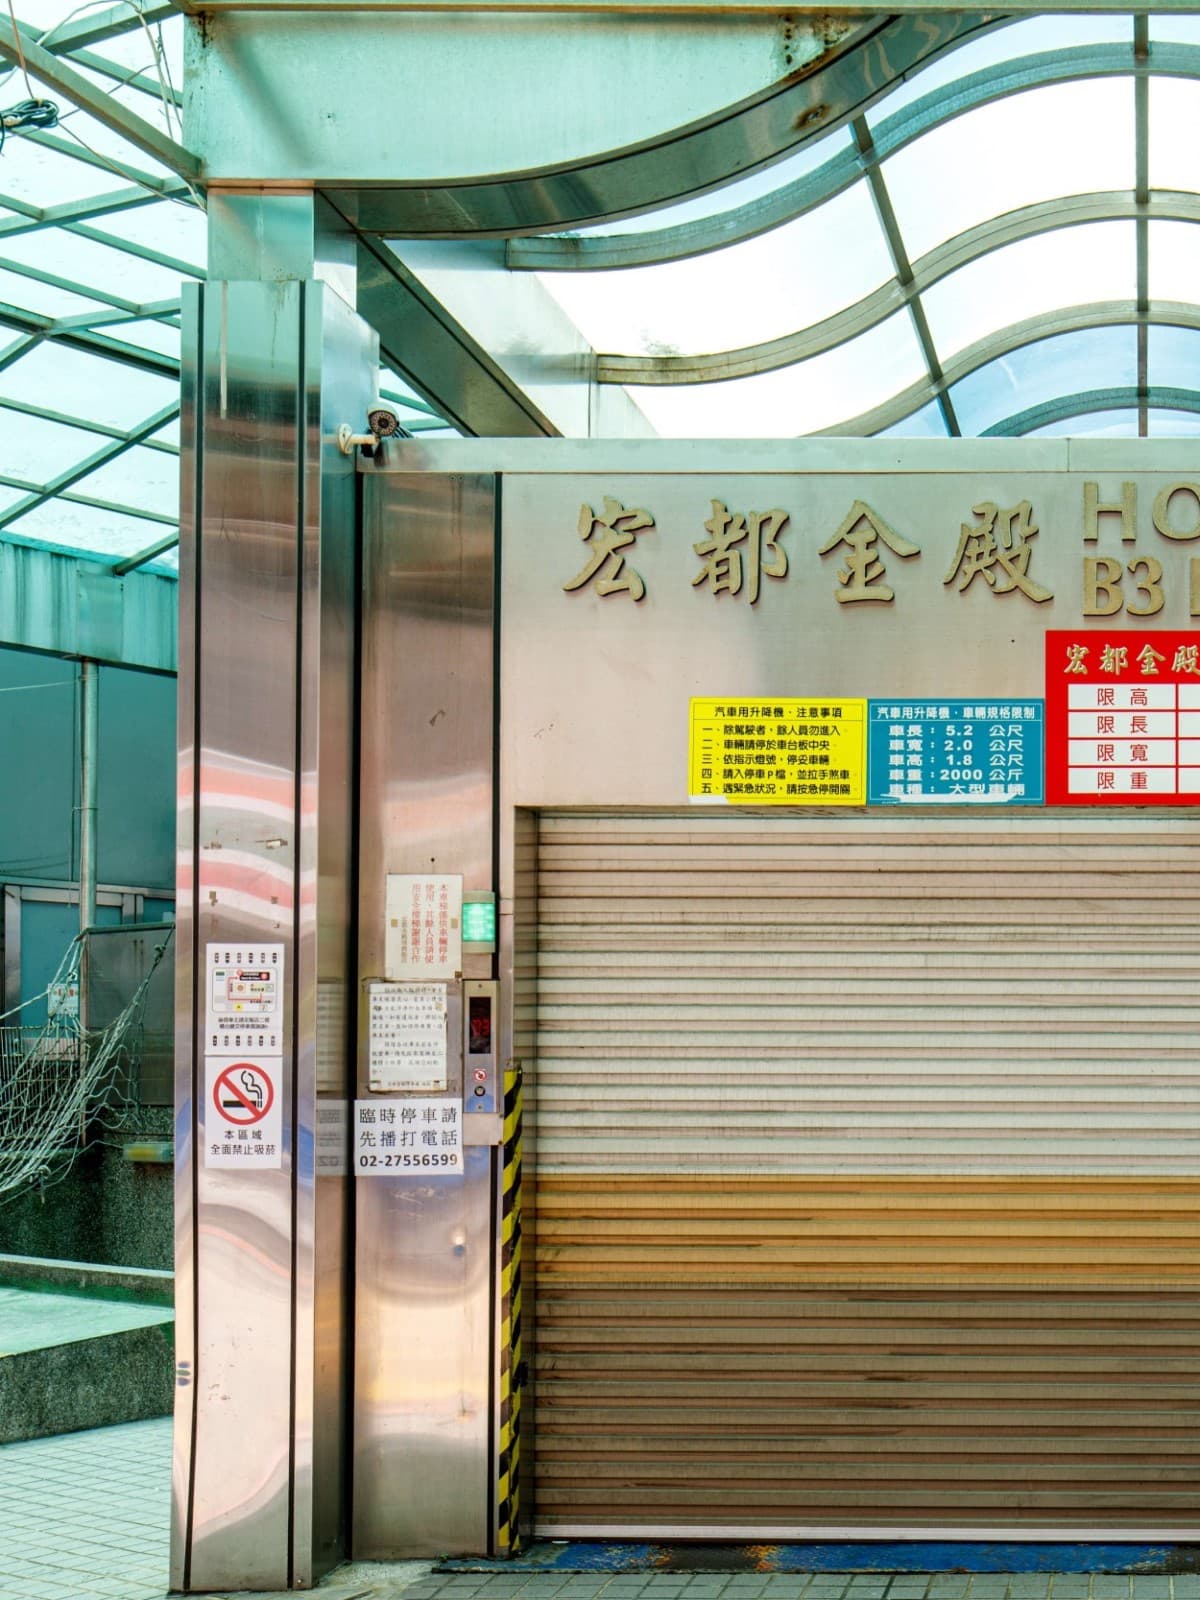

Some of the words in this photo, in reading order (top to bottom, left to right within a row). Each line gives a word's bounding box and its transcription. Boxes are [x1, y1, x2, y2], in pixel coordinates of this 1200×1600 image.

[563, 496, 1055, 604] 宏都金殿
[1083, 557, 1165, 617] B3
[1097, 688, 1148, 706] 限高
[946, 724, 973, 737] 5.2
[989, 724, 1024, 737] 公尺
[1097, 716, 1148, 734] 限長
[944, 739, 973, 752] 2.0
[989, 739, 1024, 752] 公尺
[1097, 744, 1148, 762] 限寬
[946, 754, 973, 767] 1.8
[989, 754, 1024, 767] 公尺
[940, 769, 983, 782] 2000
[989, 769, 1024, 782] 公斤
[1097, 771, 1148, 790] 限重
[359, 1107, 457, 1125] 臨時停車請
[223, 1129, 262, 1141] 本區域
[210, 1144, 276, 1156] 全面禁止吸菸
[359, 1153, 458, 1167] 02-27556599
